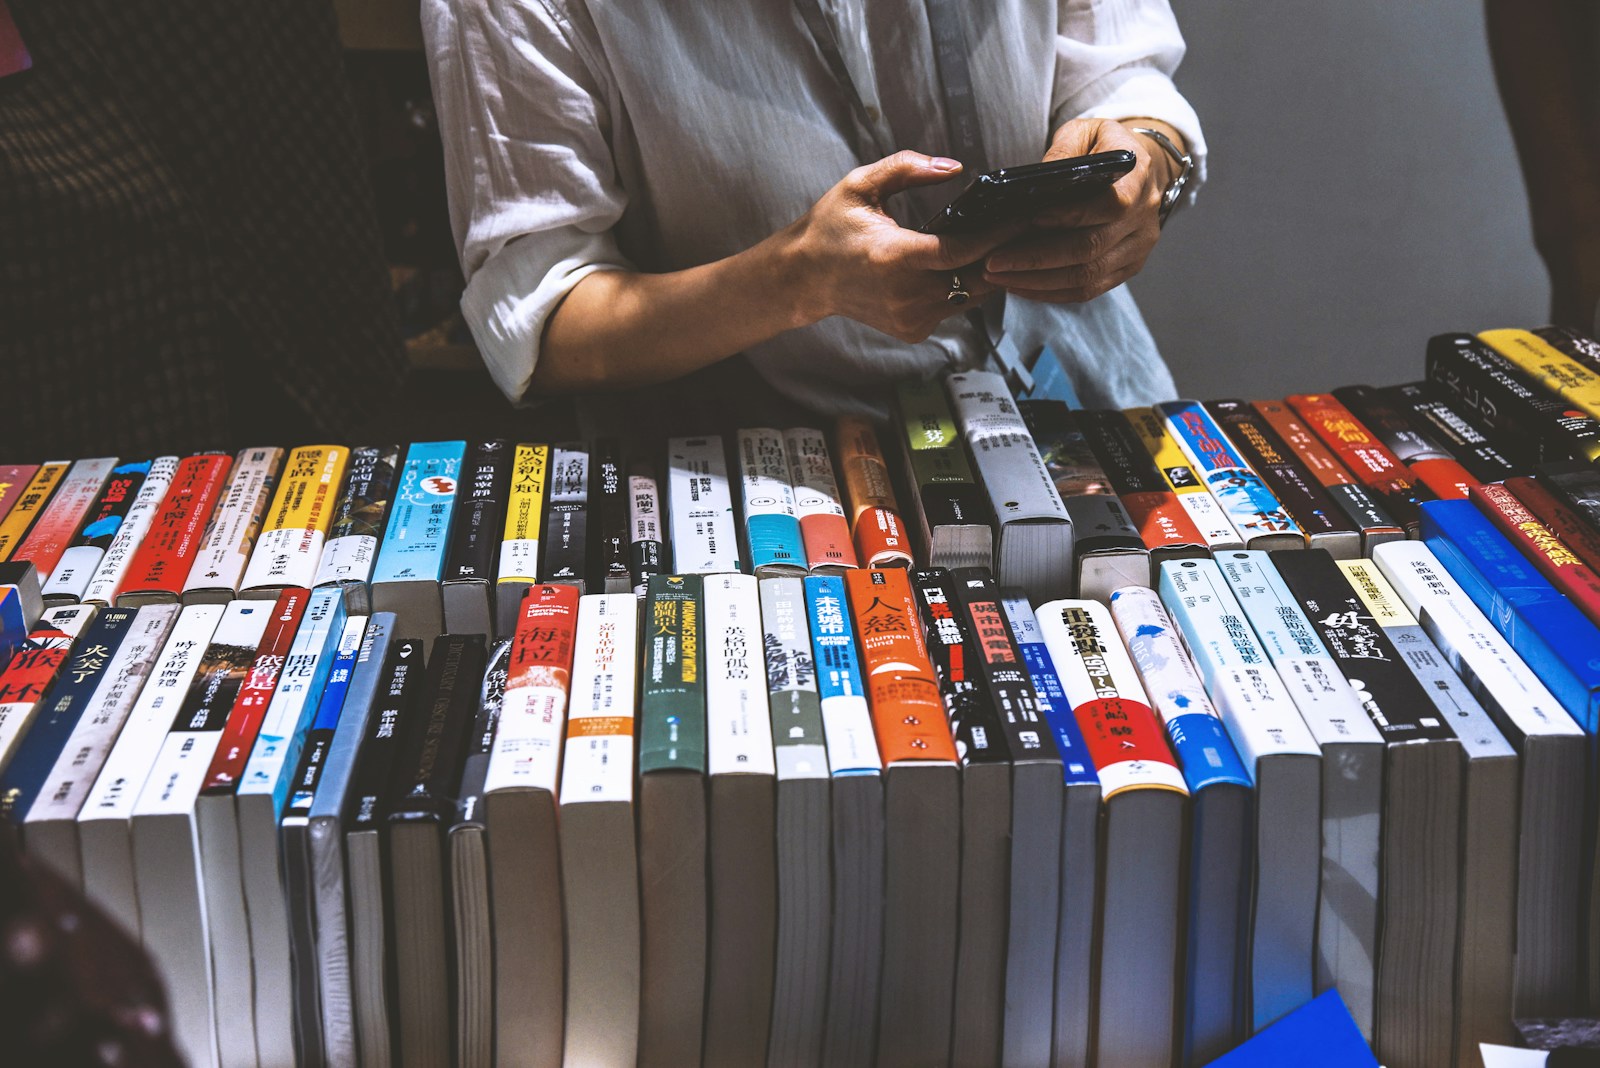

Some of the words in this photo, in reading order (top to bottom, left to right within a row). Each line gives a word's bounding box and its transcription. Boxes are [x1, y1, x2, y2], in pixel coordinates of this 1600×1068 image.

[515, 447, 545, 494] 成為新人類
[1188, 570, 1199, 582] Wim
[1224, 562, 1241, 583] Wenders
[1240, 562, 1252, 574] Wim
[1410, 561, 1450, 596] 後戲劇劇場
[1172, 571, 1188, 593] Wenders
[1238, 586, 1250, 598] Film
[1254, 586, 1265, 594] On
[1184, 596, 1196, 608] Film
[1200, 595, 1211, 603] On
[815, 596, 844, 634] 未來城市
[860, 596, 907, 635] 人慈
[516, 627, 558, 663] 海拉
[865, 635, 910, 643] Human
[866, 640, 894, 649] kind
[974, 603, 1016, 662] 城市與電影
[0, 650, 63, 702] 猴杯
[72, 644, 110, 684] 火笑了
[157, 641, 197, 688] 時差的贈禮
[284, 655, 318, 677] 開花
[92, 645, 147, 725] 南洋人民共和國備忘錄
[376, 710, 398, 738] 夢中書房
